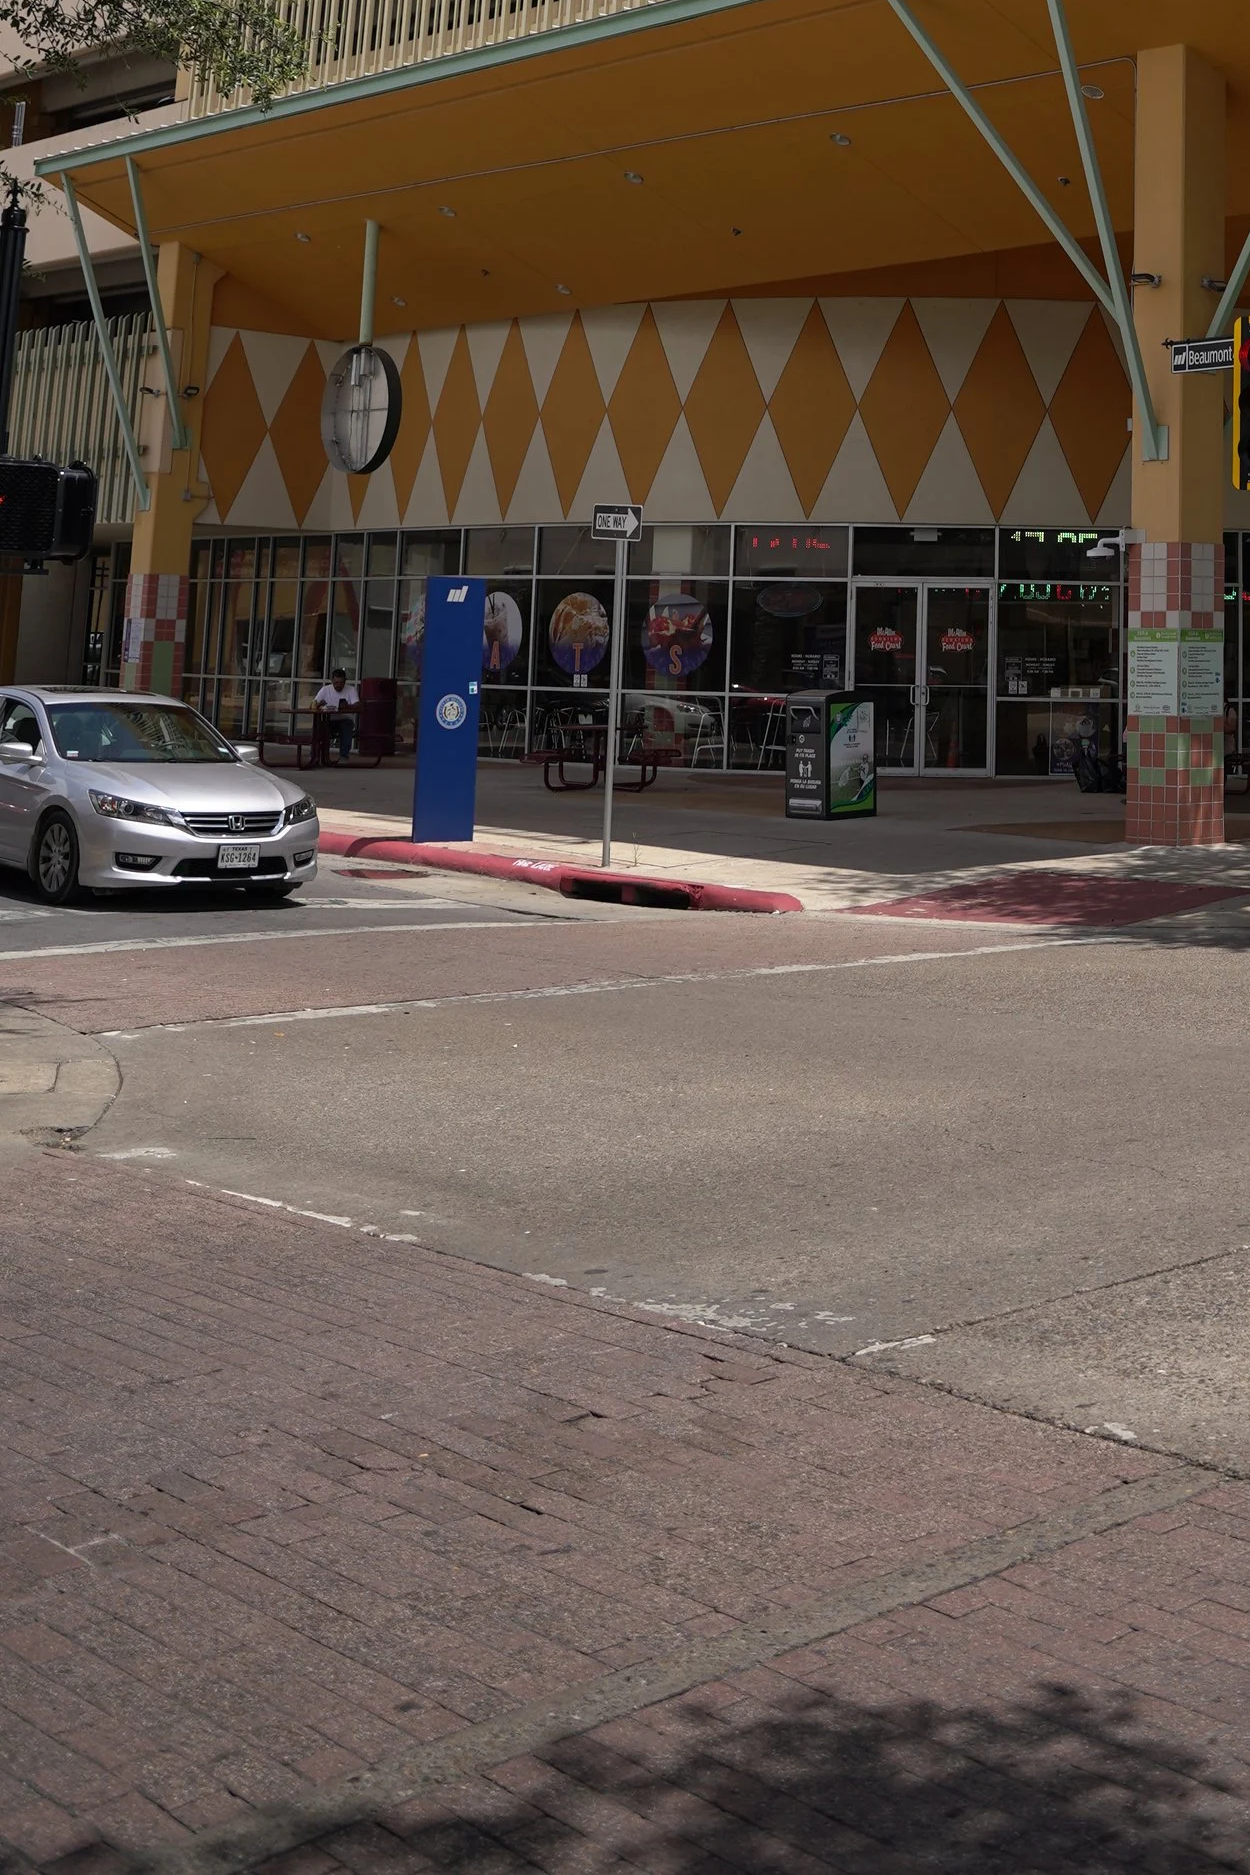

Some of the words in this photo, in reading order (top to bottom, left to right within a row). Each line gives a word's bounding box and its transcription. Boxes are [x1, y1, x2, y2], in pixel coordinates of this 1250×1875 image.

[1189, 346, 1233, 365] Beaumont
[598, 515, 611, 528] ONE
[613, 516, 627, 529] WAY
